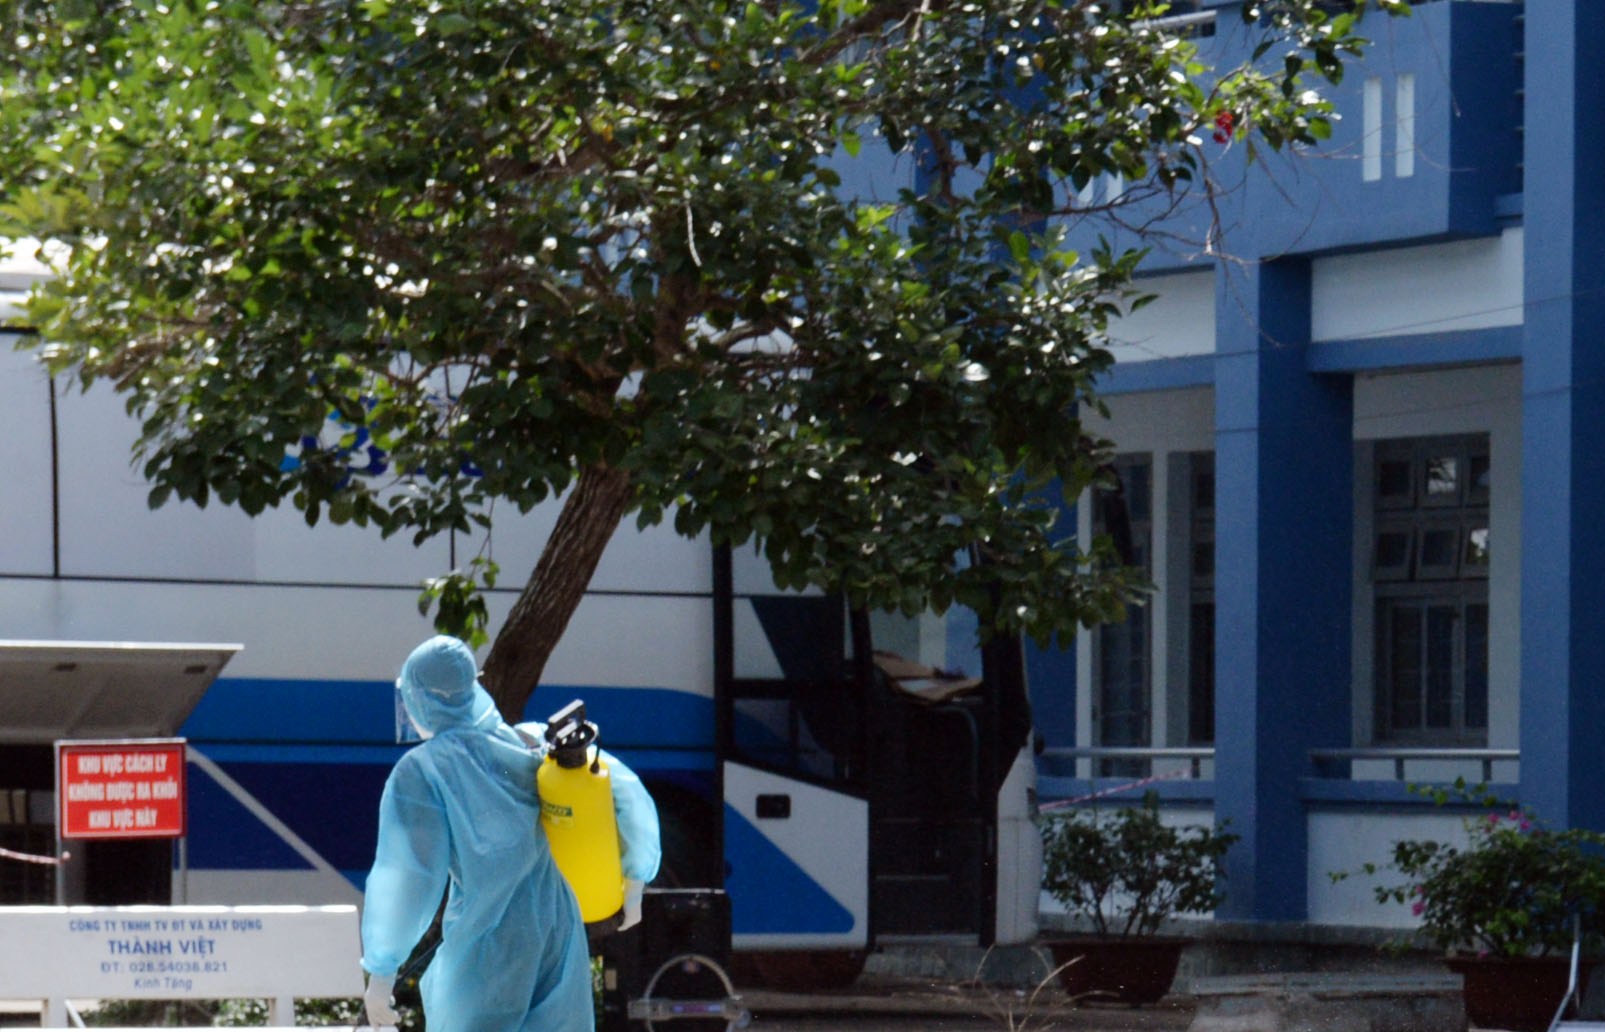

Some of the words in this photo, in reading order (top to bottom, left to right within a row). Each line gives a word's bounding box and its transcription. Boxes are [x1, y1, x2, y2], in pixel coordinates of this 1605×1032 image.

[125, 752, 154, 773] CÁCH
[155, 754, 168, 772] LY
[69, 917, 100, 933] CÔNG
[104, 919, 117, 932] TY
[121, 919, 151, 932] TNHH
[155, 919, 168, 932] TV
[108, 935, 172, 954] THÀNH
[178, 934, 216, 959] VIỆT
